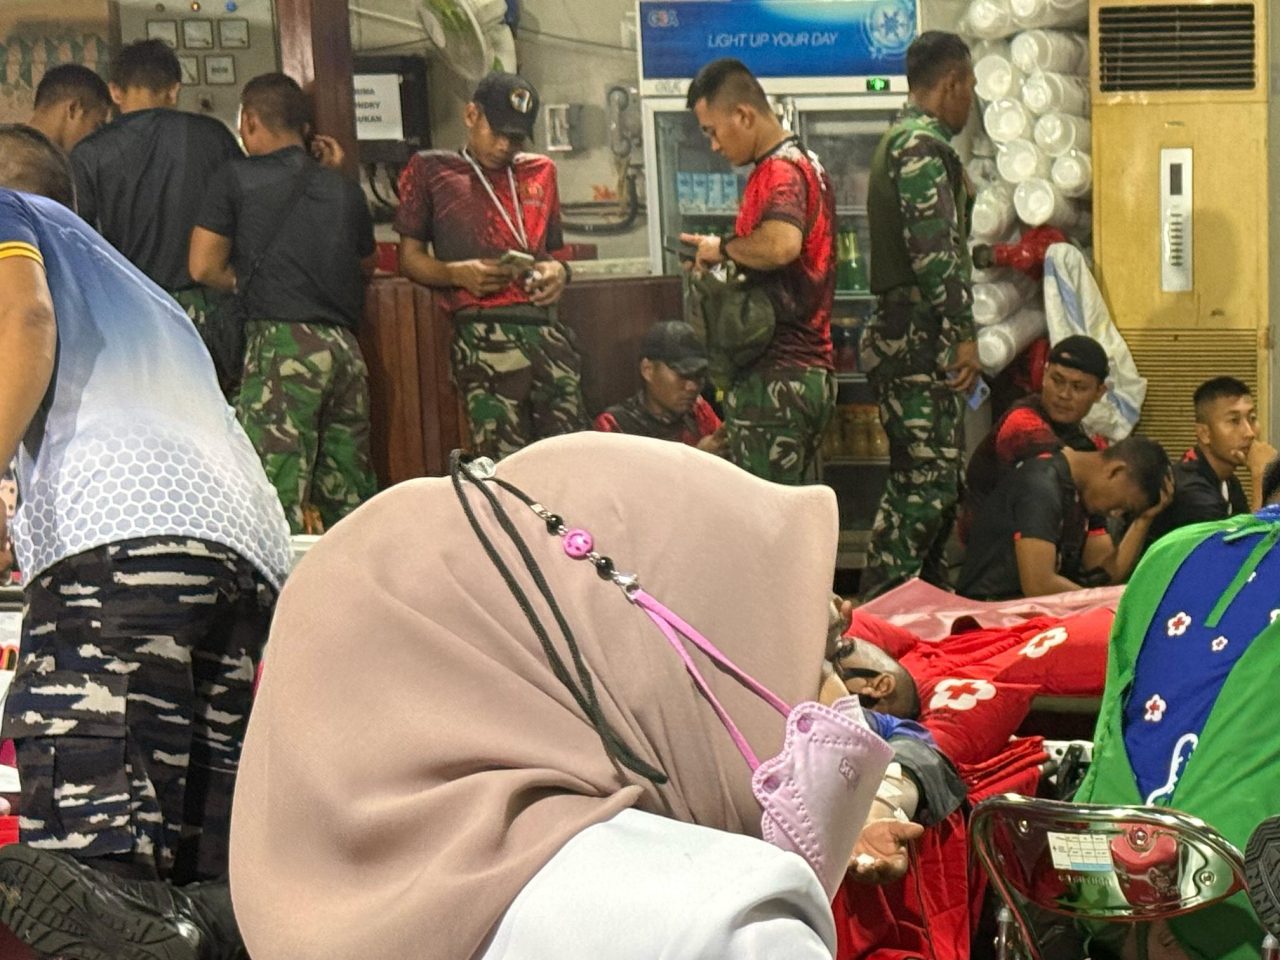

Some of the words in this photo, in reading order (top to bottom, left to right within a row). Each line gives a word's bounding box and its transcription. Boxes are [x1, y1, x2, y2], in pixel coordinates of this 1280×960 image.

[708, 33, 748, 48] LIGHT
[750, 33, 769, 47] UP
[772, 32, 808, 47] YOUR
[811, 32, 838, 45] DAY
